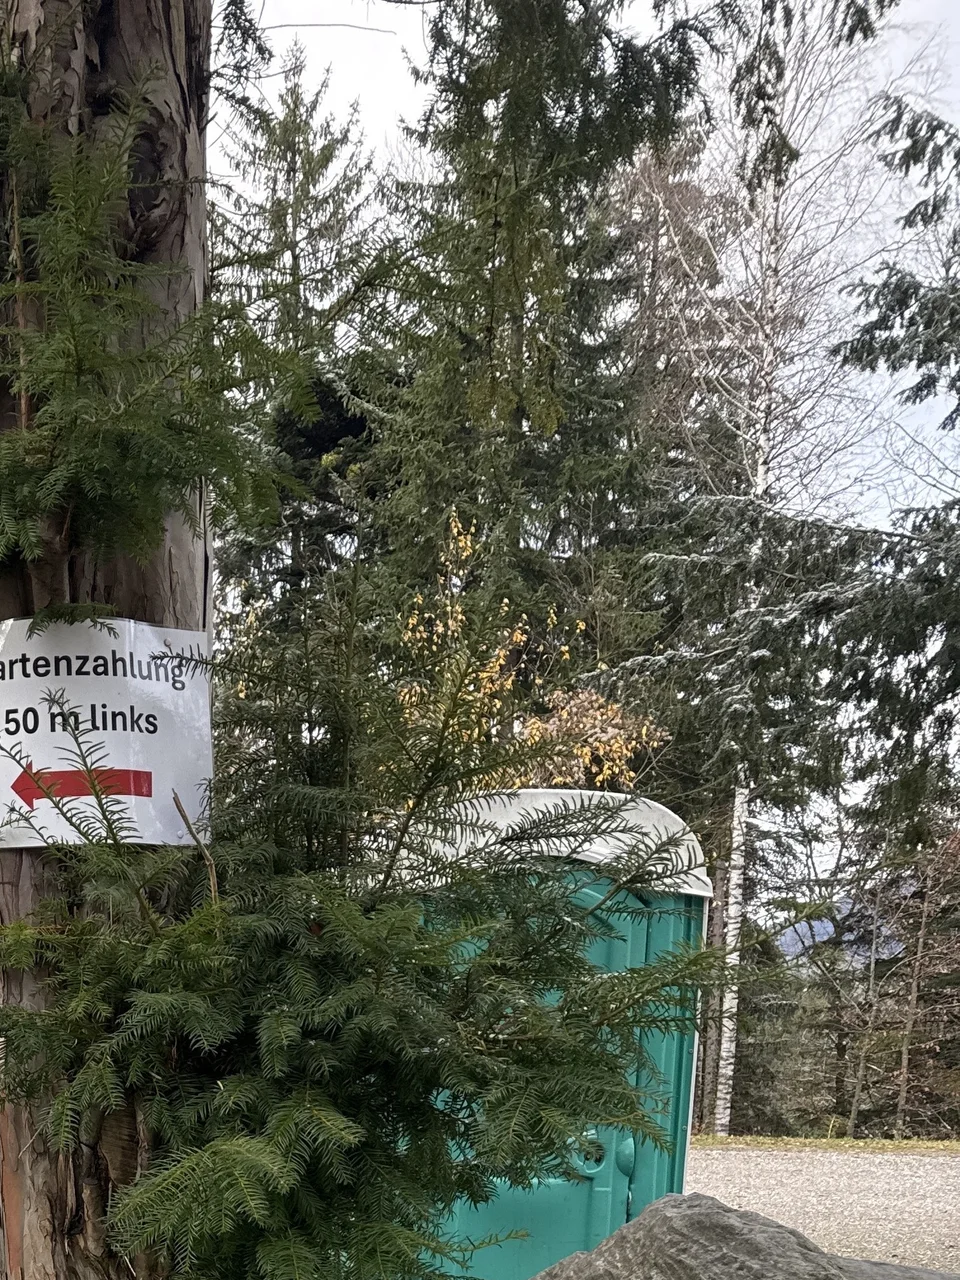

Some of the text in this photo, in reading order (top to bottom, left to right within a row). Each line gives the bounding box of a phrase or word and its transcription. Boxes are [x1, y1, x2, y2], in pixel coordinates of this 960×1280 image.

[4, 703, 159, 736] 50 m links
